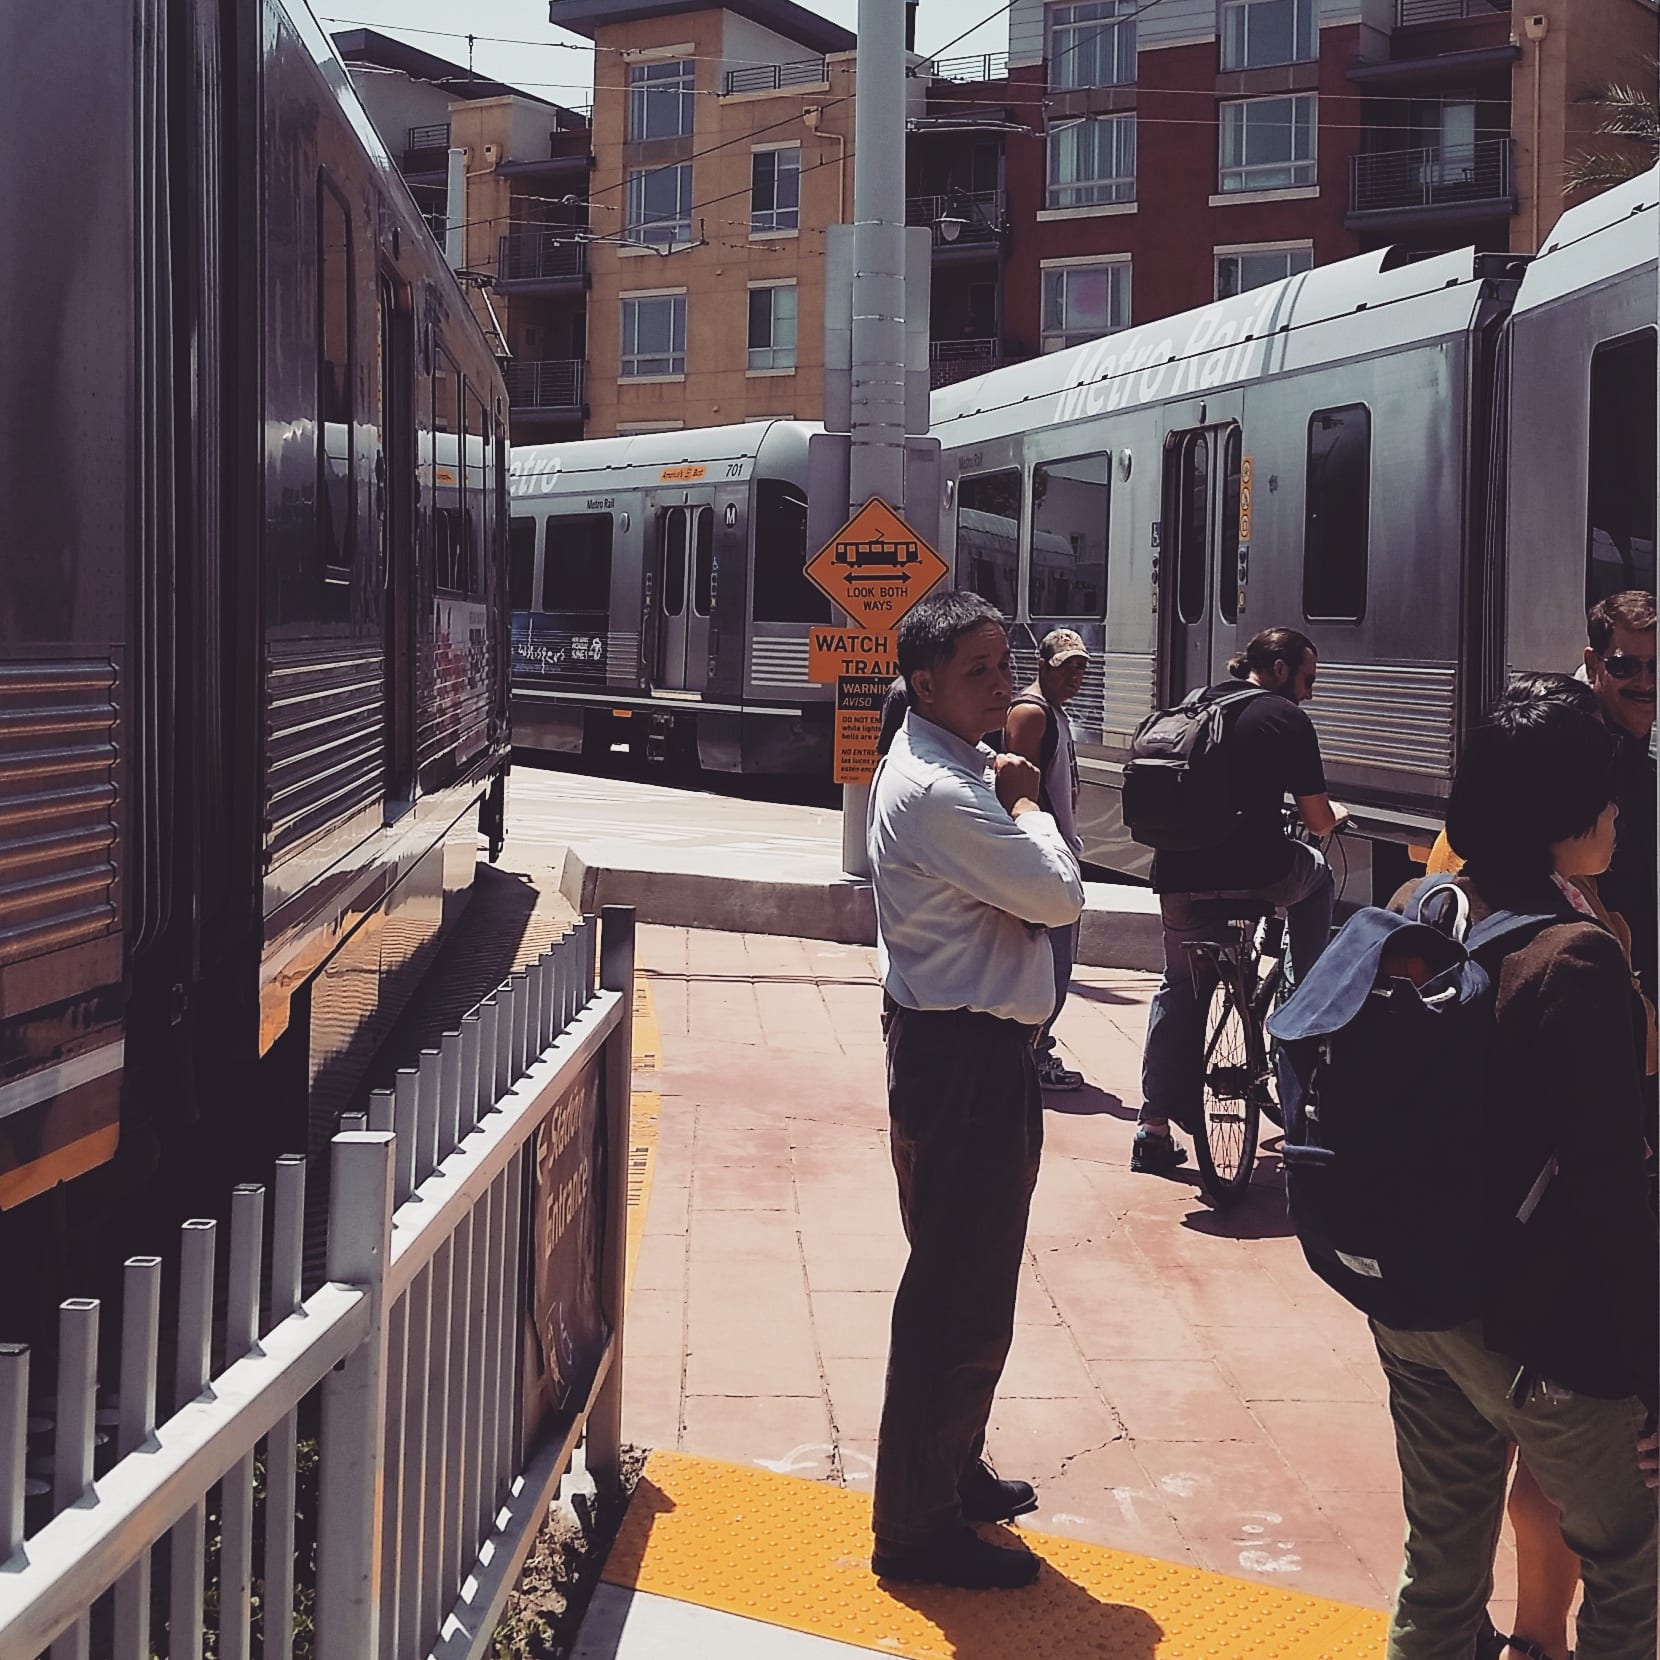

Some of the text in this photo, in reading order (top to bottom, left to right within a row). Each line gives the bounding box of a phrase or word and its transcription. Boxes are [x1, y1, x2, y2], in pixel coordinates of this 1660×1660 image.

[1052, 285, 1280, 424] Metro Rail
[510, 451, 561, 496] etro
[725, 463, 744, 477] 701
[847, 587, 908, 598] LOOK BOTH
[863, 600, 893, 611] WAYS
[815, 634, 888, 654] WATCH
[842, 683, 889, 695] WARNIN
[841, 697, 872, 707] AVISO
[841, 748, 852, 756] NO
[548, 1086, 585, 1169] Station
[545, 1156, 588, 1261] Entrance
